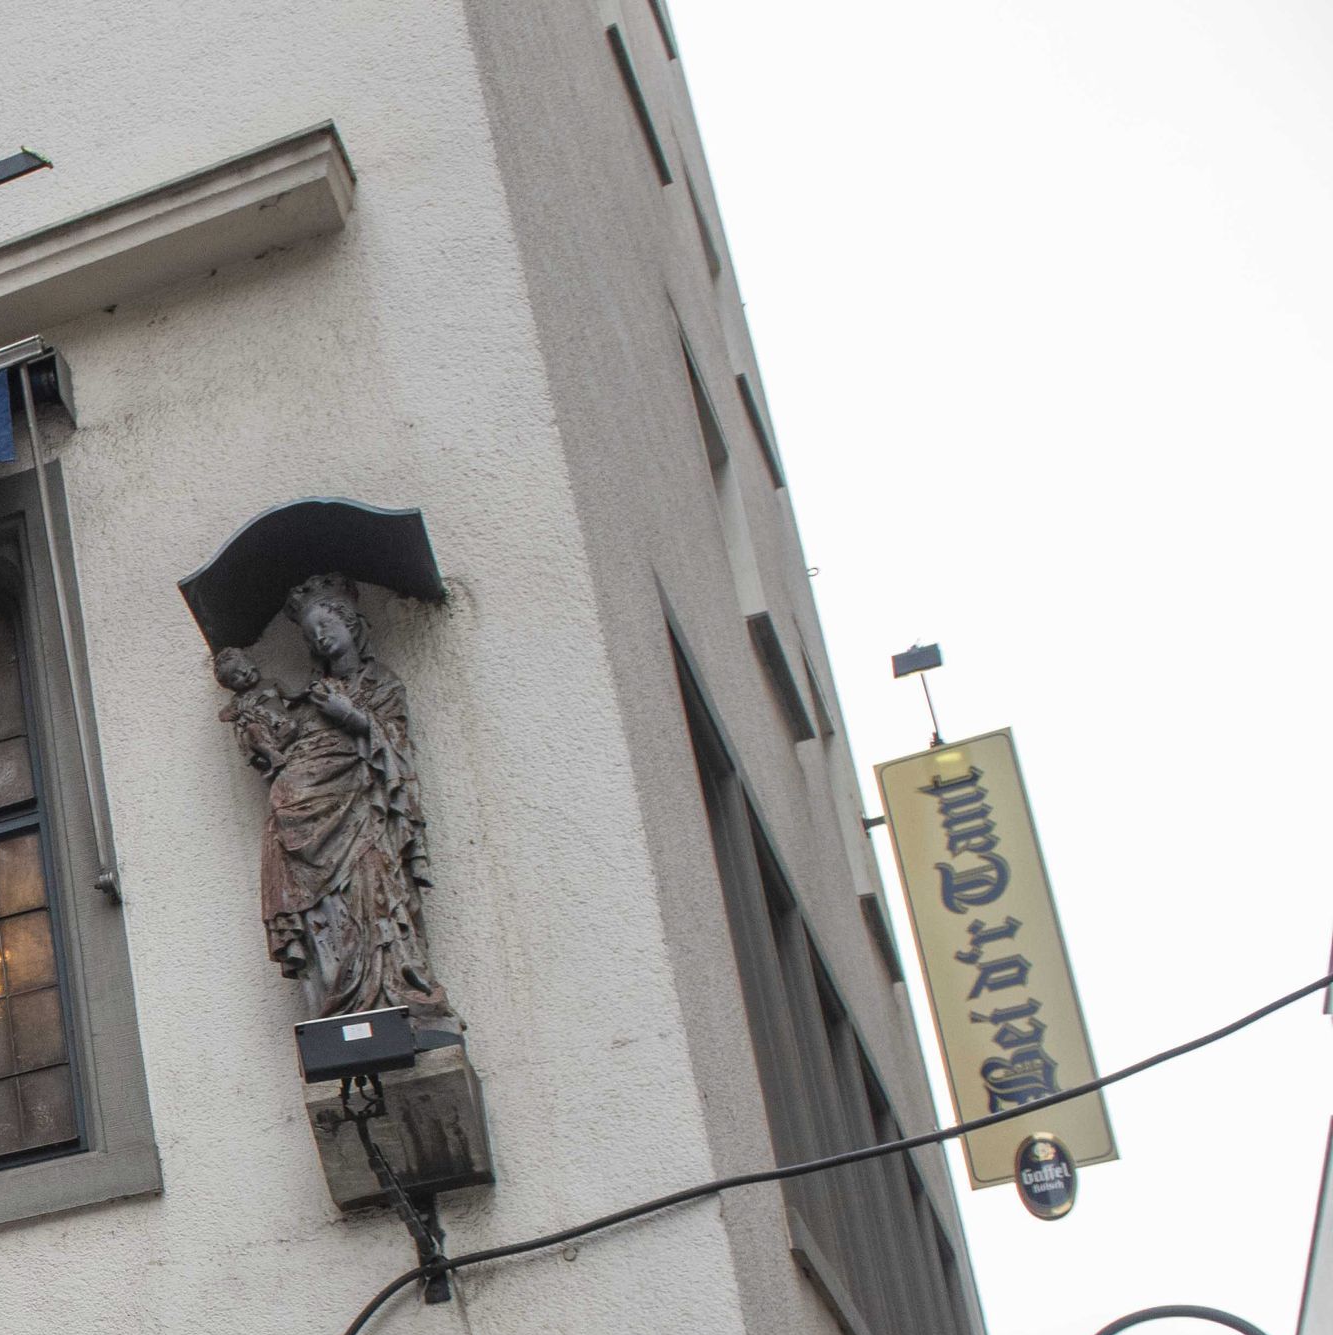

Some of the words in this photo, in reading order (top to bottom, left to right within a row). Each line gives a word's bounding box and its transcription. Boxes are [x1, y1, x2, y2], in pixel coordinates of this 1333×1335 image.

[917, 765, 1012, 914] Tant
[970, 998, 1063, 1114] Bei
[1021, 1162, 1072, 1186] Gaffel
